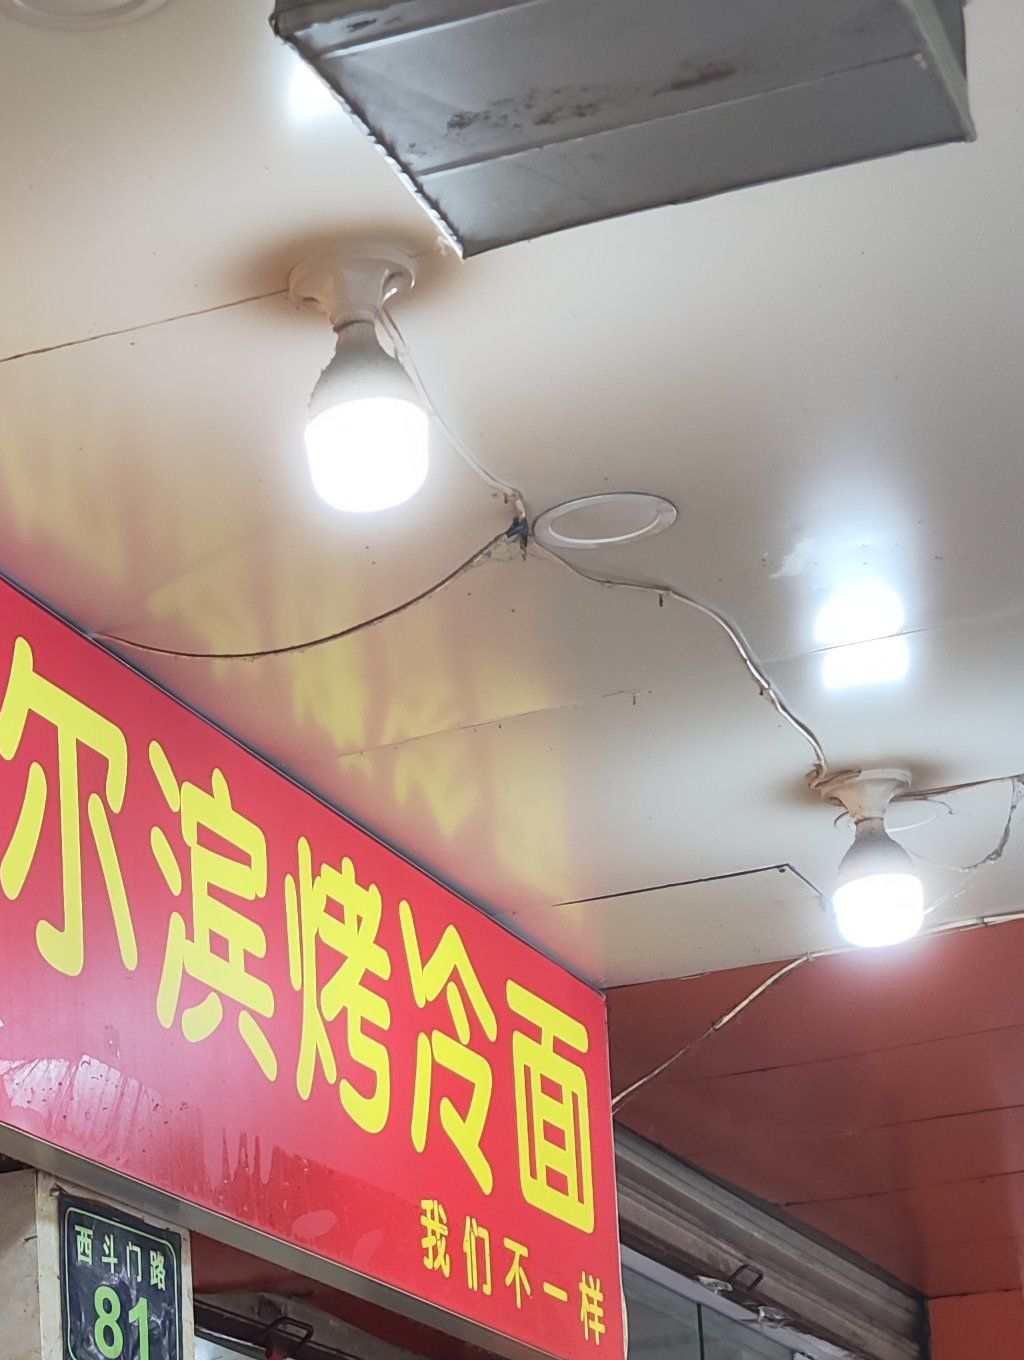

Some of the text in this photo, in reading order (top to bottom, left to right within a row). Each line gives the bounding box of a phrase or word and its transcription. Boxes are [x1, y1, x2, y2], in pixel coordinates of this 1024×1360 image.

[75, 1224, 166, 1292] 西斗门路
[420, 1199, 606, 1346] 我们不一样
